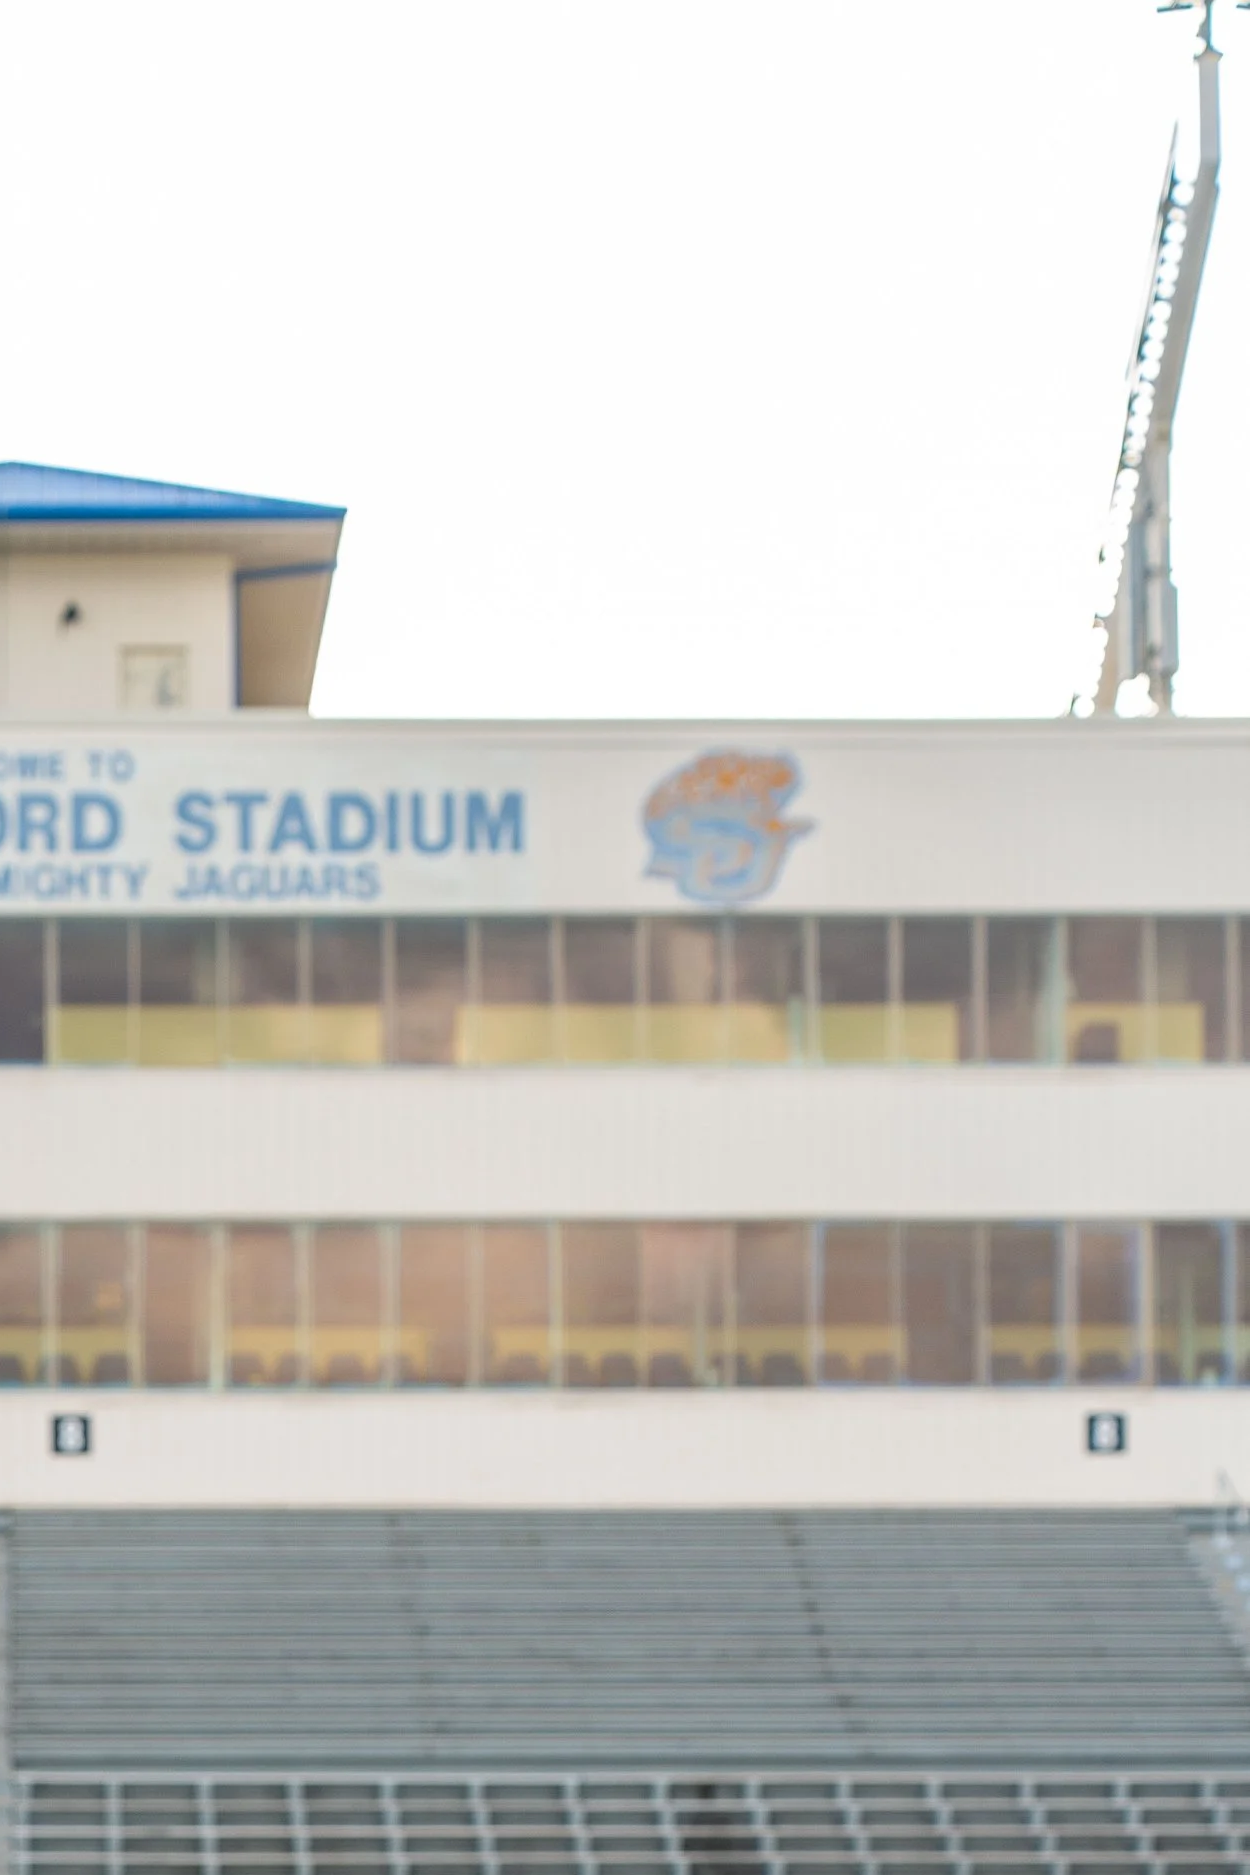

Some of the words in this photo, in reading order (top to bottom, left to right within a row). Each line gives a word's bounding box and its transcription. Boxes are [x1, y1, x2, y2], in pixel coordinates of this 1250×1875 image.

[88, 752, 137, 783] TO
[174, 790, 526, 856] STADIUM
[174, 863, 381, 902] JAGUARS
